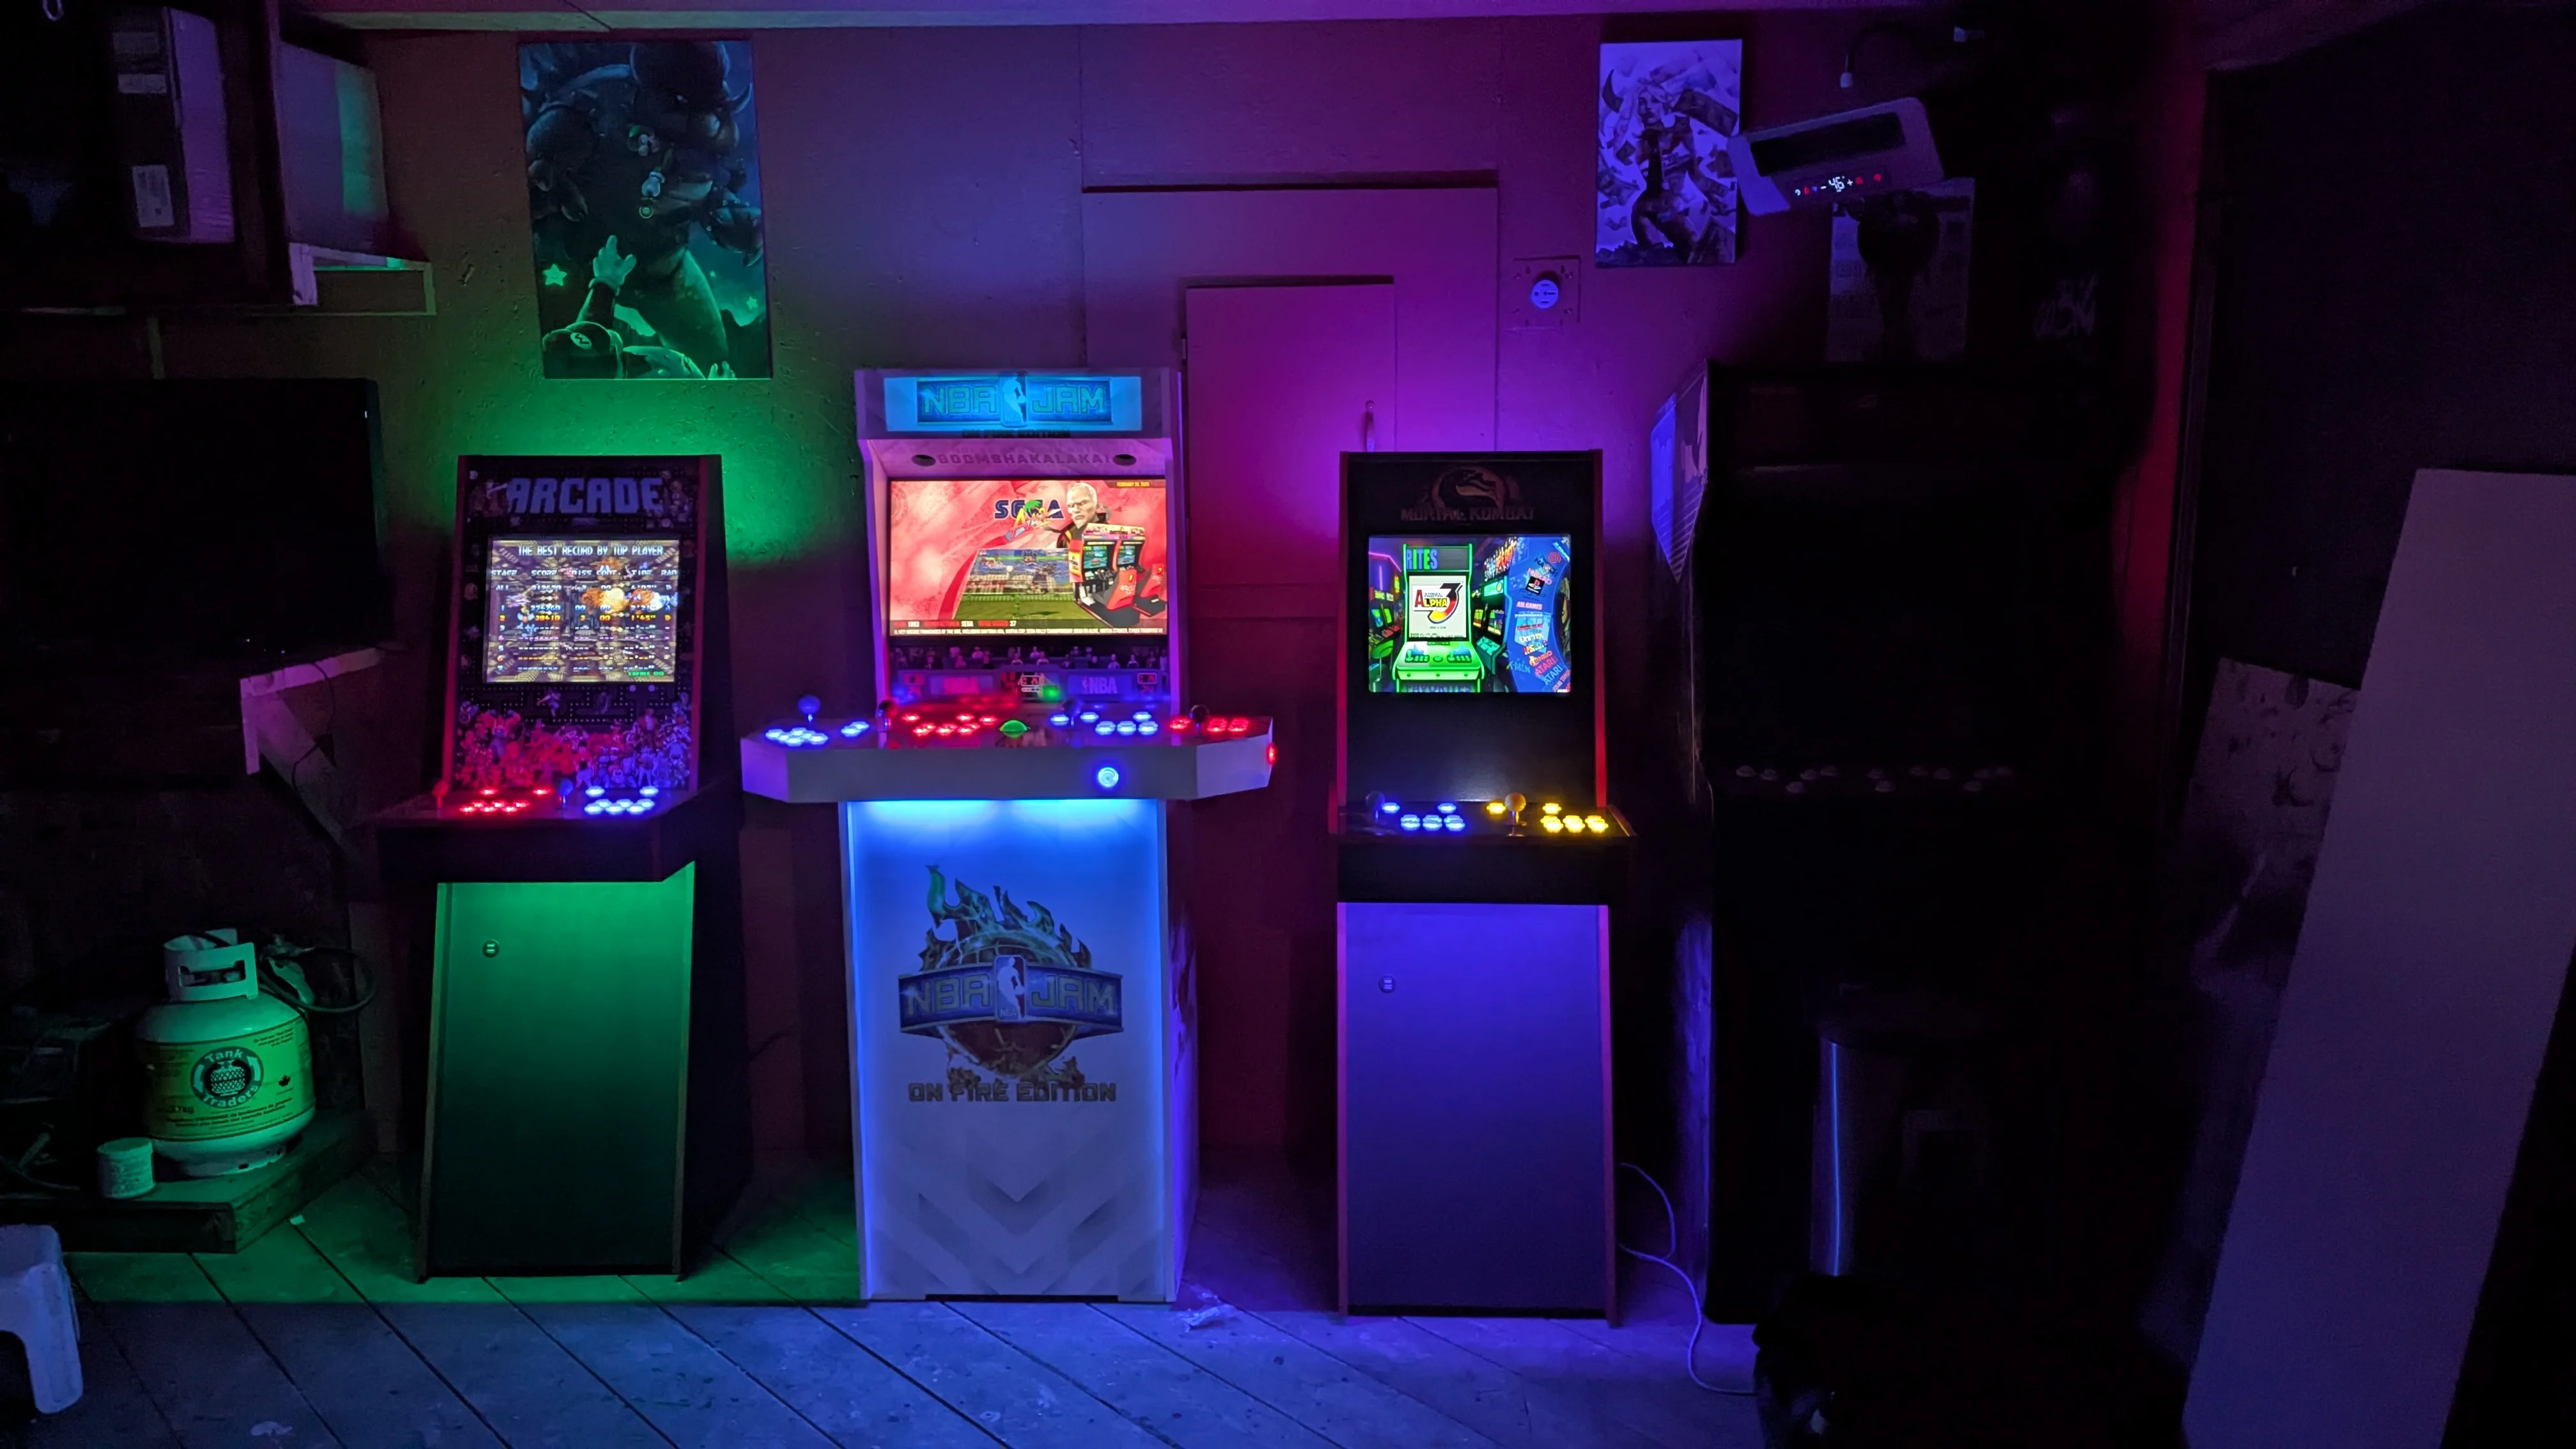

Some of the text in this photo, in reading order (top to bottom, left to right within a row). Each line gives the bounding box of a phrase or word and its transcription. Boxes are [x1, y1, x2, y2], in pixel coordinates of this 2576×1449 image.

[923, 385, 1106, 414] NBA JAM
[507, 477, 663, 514] ARCADE
[1469, 507, 1535, 521] KOMBAT
[518, 546, 664, 556] THE BEST RECORD BY TOP PLAYER
[1406, 548, 1438, 570] RITES
[1414, 590, 1448, 608] ALPHA
[1088, 677, 1118, 694] NBA
[1542, 664, 1564, 686] ATARI
[907, 973, 1115, 1017] NBA JAM
[204, 1048, 243, 1063] Tank
[203, 1085, 258, 1108] Traders
[908, 1082, 1117, 1103] ON FIRE EDITION
